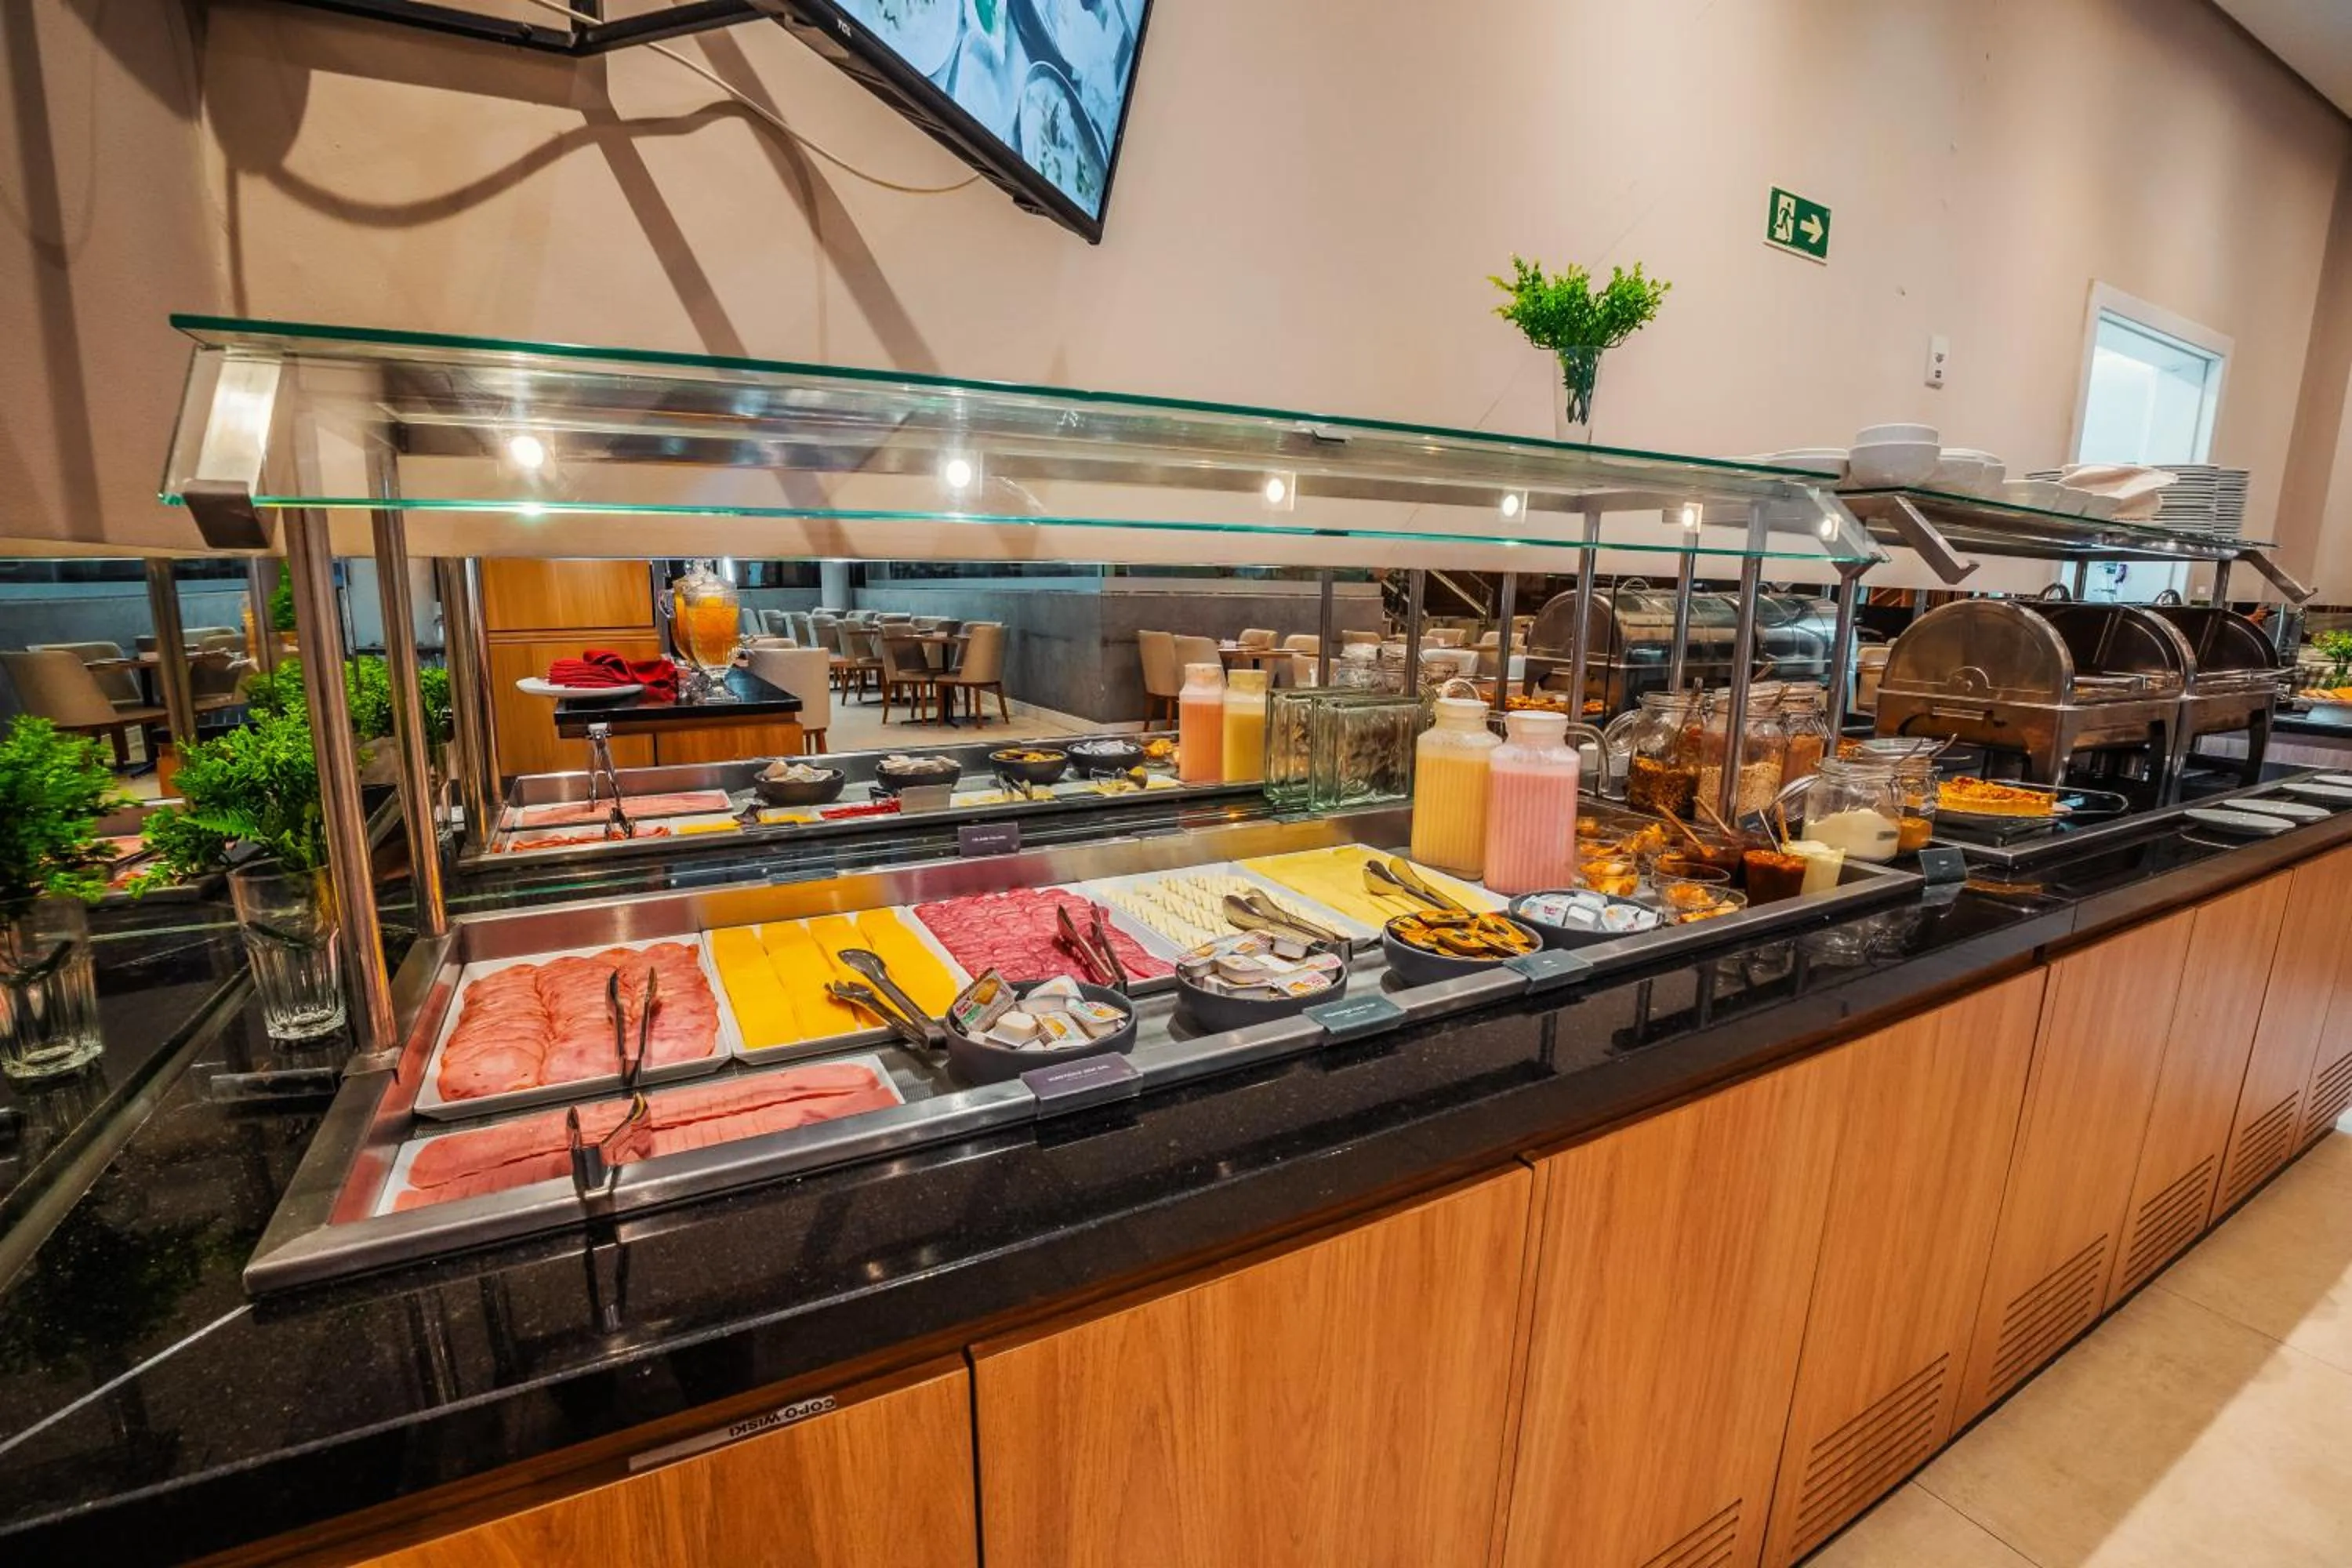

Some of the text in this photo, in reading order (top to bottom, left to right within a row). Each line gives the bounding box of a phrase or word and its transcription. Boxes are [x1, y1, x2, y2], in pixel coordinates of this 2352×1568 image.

[837, 18, 852, 38] TCL
[728, 1398, 835, 1437] COPO WISKI
